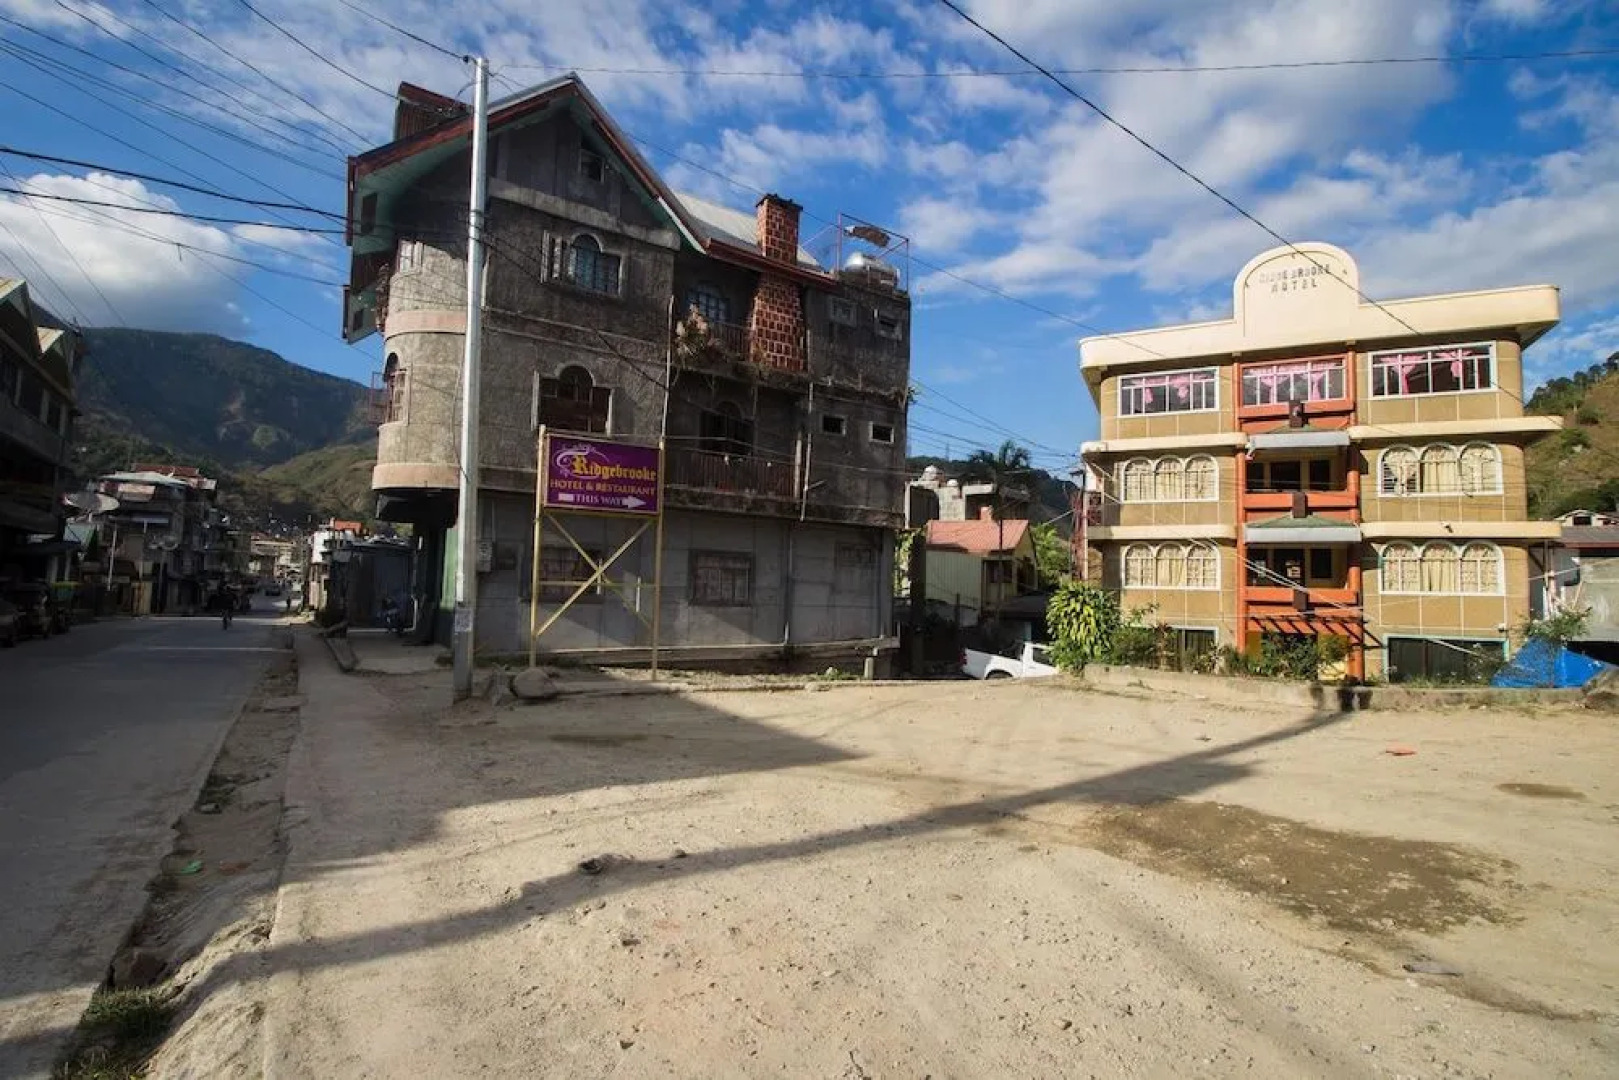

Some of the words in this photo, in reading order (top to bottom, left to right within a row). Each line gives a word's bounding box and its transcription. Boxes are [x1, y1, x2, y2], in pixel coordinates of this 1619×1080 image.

[571, 455, 656, 480] Ridgebrooke
[550, 479, 584, 490] HOTEL
[586, 482, 594, 490] &
[575, 493, 599, 503] THIS
[601, 496, 623, 506] WAY
